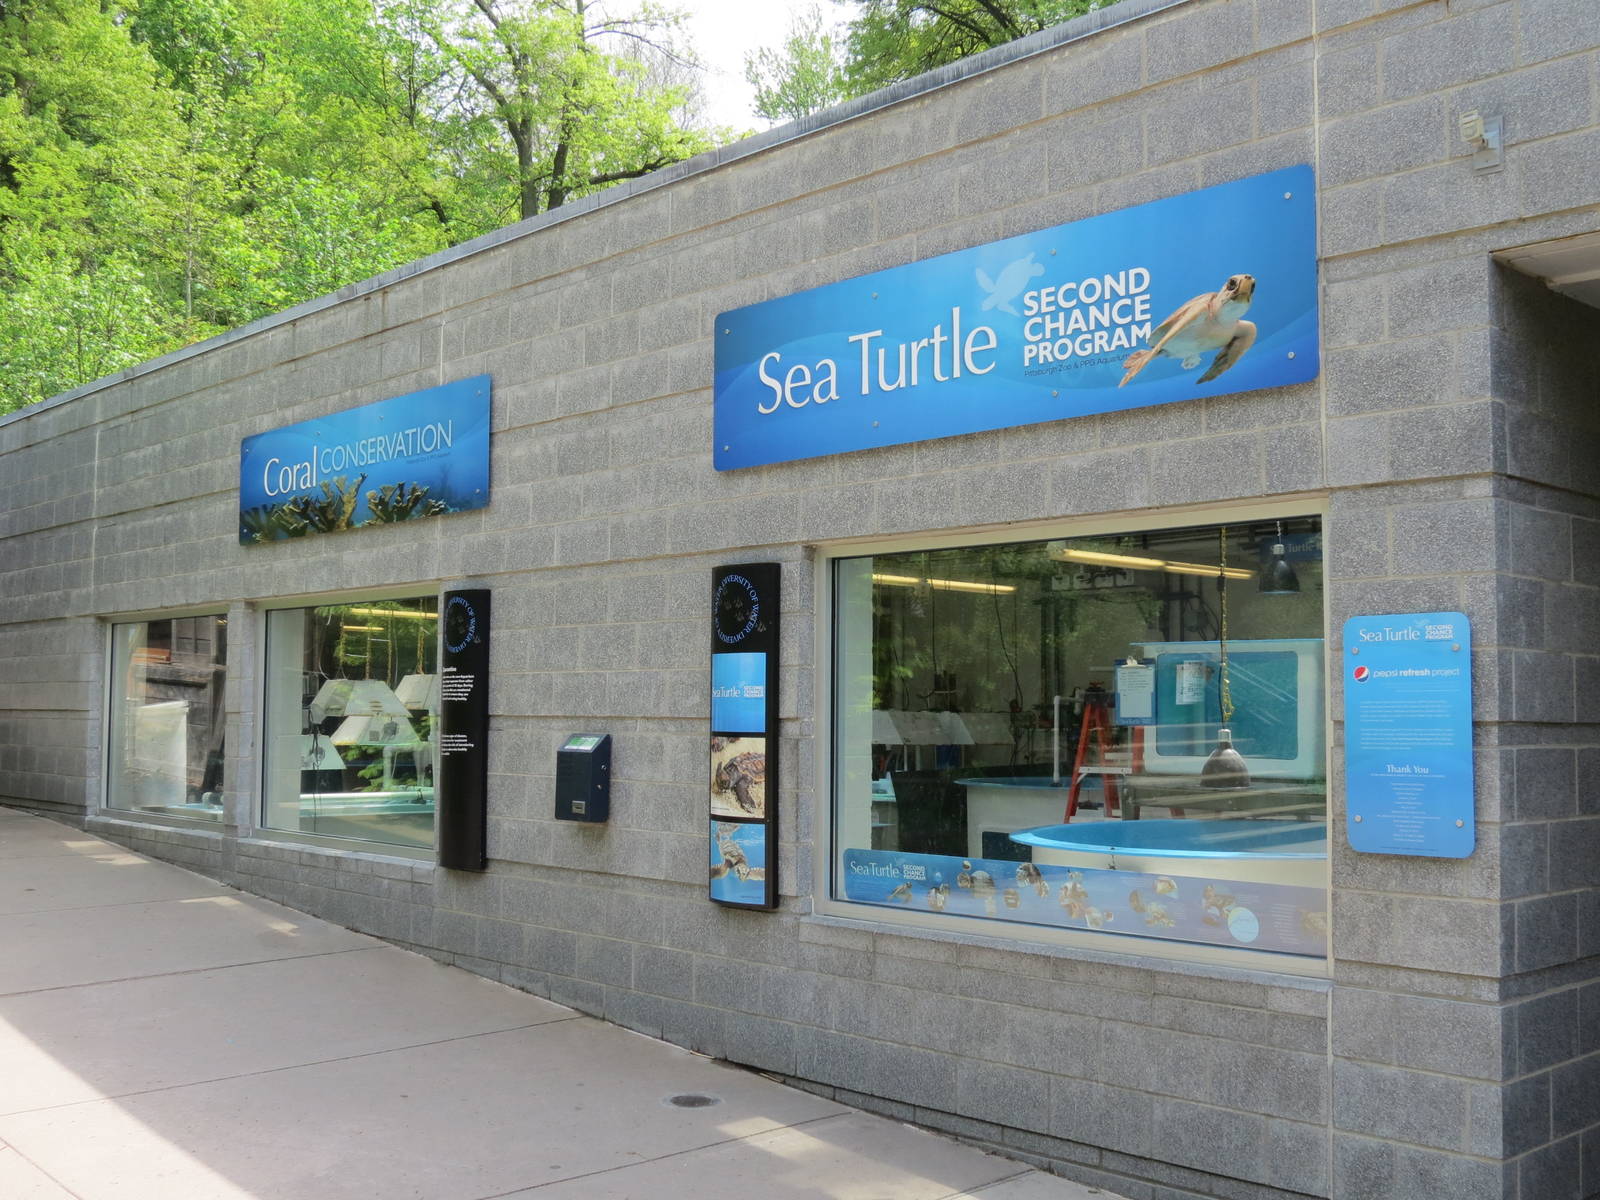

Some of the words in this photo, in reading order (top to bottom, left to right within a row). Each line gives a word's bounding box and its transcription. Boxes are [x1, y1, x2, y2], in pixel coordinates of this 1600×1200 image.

[1023, 267, 1151, 317] SECOND
[1023, 294, 1152, 342] CHANCE
[758, 351, 840, 415] Sea
[848, 306, 997, 395] Turtle
[1023, 321, 1152, 367] PROGRAM
[264, 445, 317, 497] Coral
[320, 419, 452, 474] CONSERVATION
[1359, 628, 1382, 641] Sea
[1383, 626, 1420, 641] Turtle
[1373, 669, 1398, 678] pepsi
[1400, 668, 1430, 677] refresh
[1431, 668, 1459, 678] project
[1386, 764, 1412, 773] Thank
[1413, 765, 1429, 774] You
[850, 860, 869, 876] Sea
[868, 862, 900, 878] Turtle
